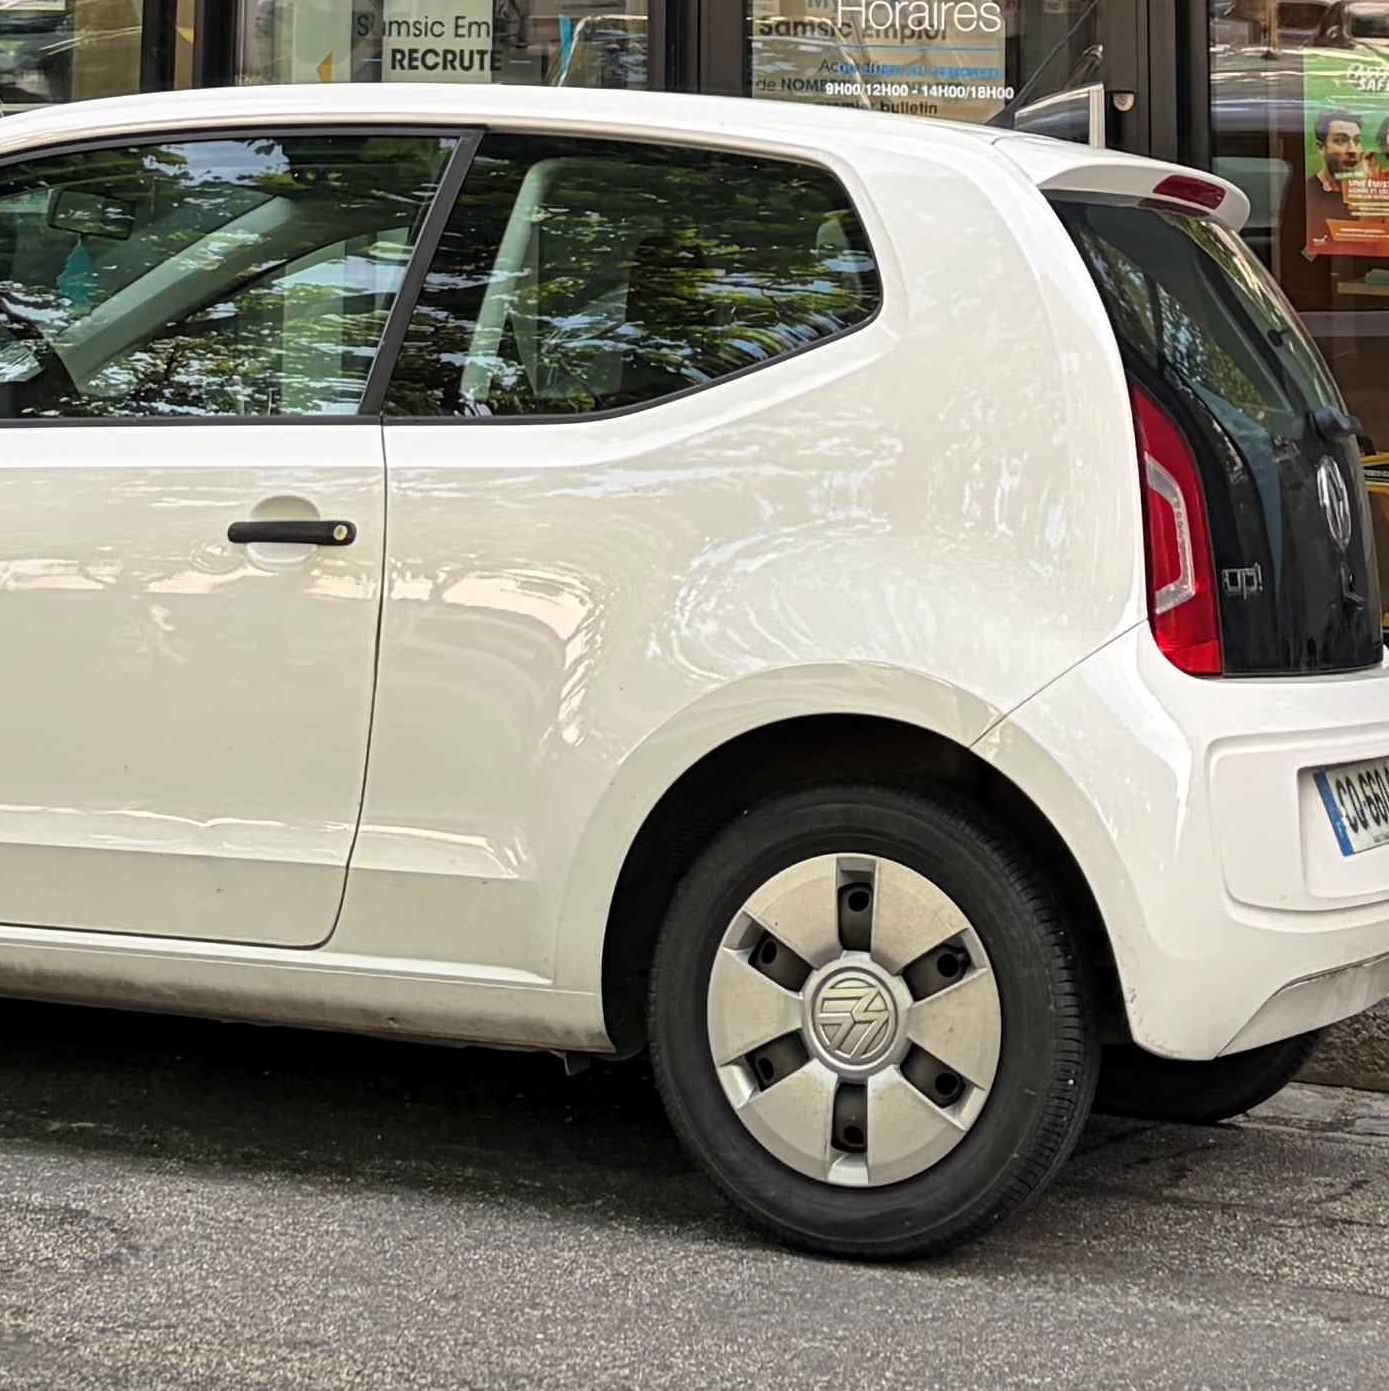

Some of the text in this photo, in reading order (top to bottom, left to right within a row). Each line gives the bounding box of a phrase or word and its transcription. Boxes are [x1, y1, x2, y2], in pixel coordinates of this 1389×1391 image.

[390, 47, 503, 72] RECRUTE
[824, 81, 910, 98] 9H00/12H00
[921, 83, 1015, 101] 14H00/18H00
[879, 101, 938, 115] bulletin
